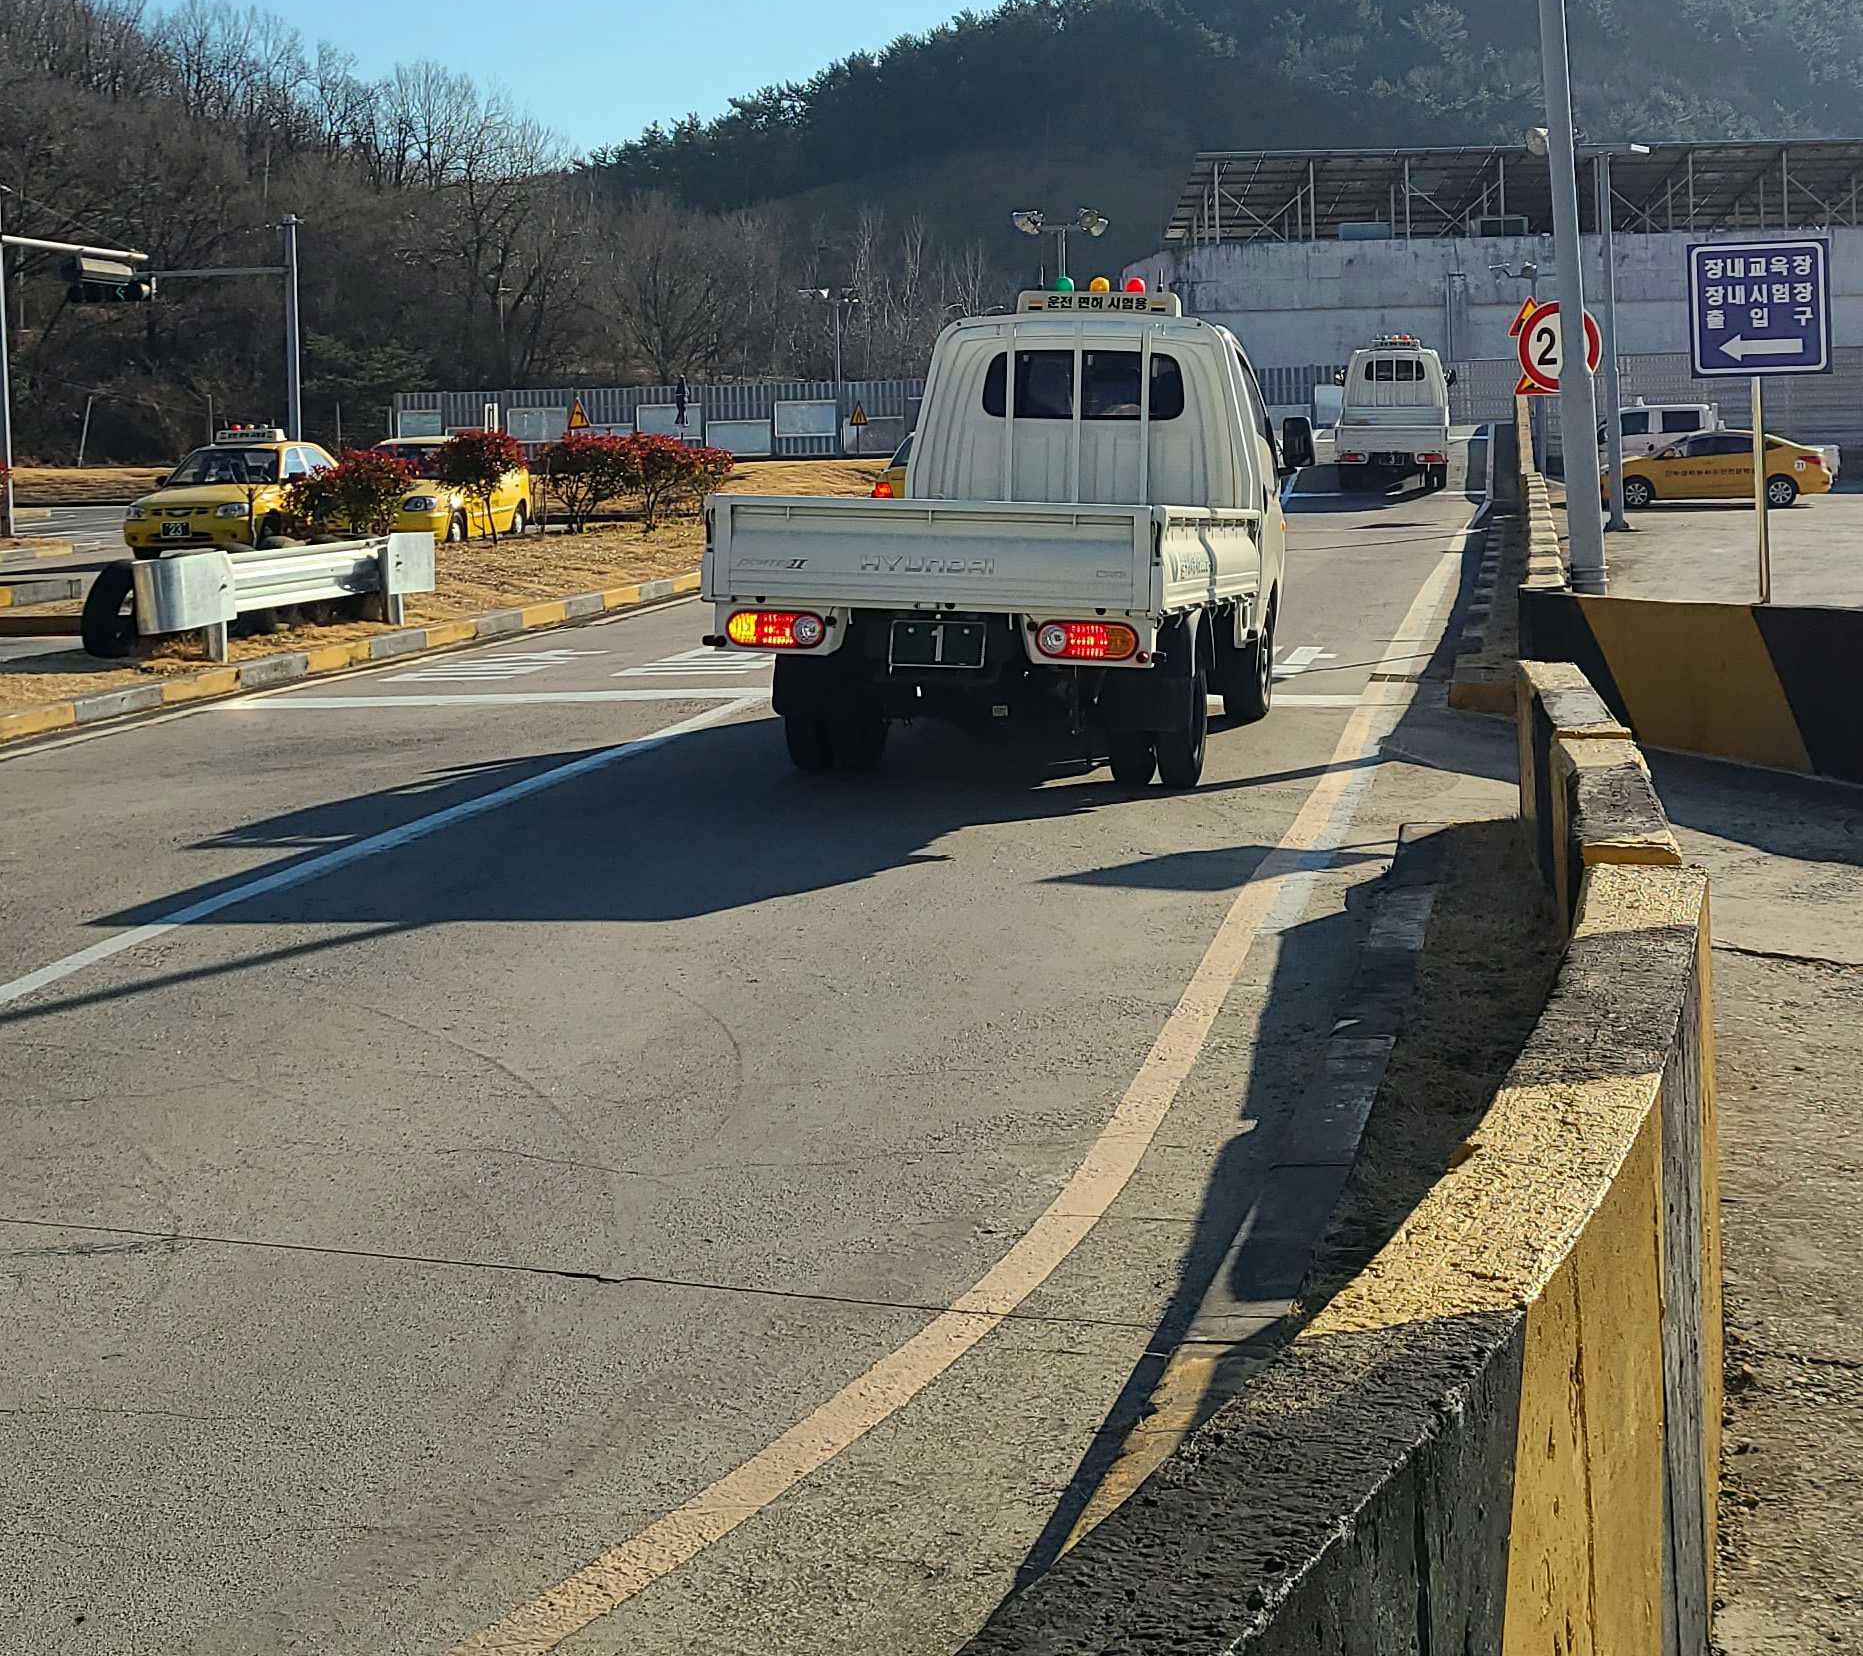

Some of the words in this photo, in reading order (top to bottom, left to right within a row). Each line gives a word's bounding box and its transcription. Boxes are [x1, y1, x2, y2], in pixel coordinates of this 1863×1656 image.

[1705, 255, 1812, 279] 장내교육장
[1048, 296, 1072, 309] 운전
[1078, 297, 1103, 310] 면허
[1107, 297, 1147, 311] 시험용
[1705, 282, 1813, 306] 장내시험장
[1536, 327, 1557, 366] 2
[860, 554, 995, 575] HYUNDAI
[931, 625, 944, 662] 1
